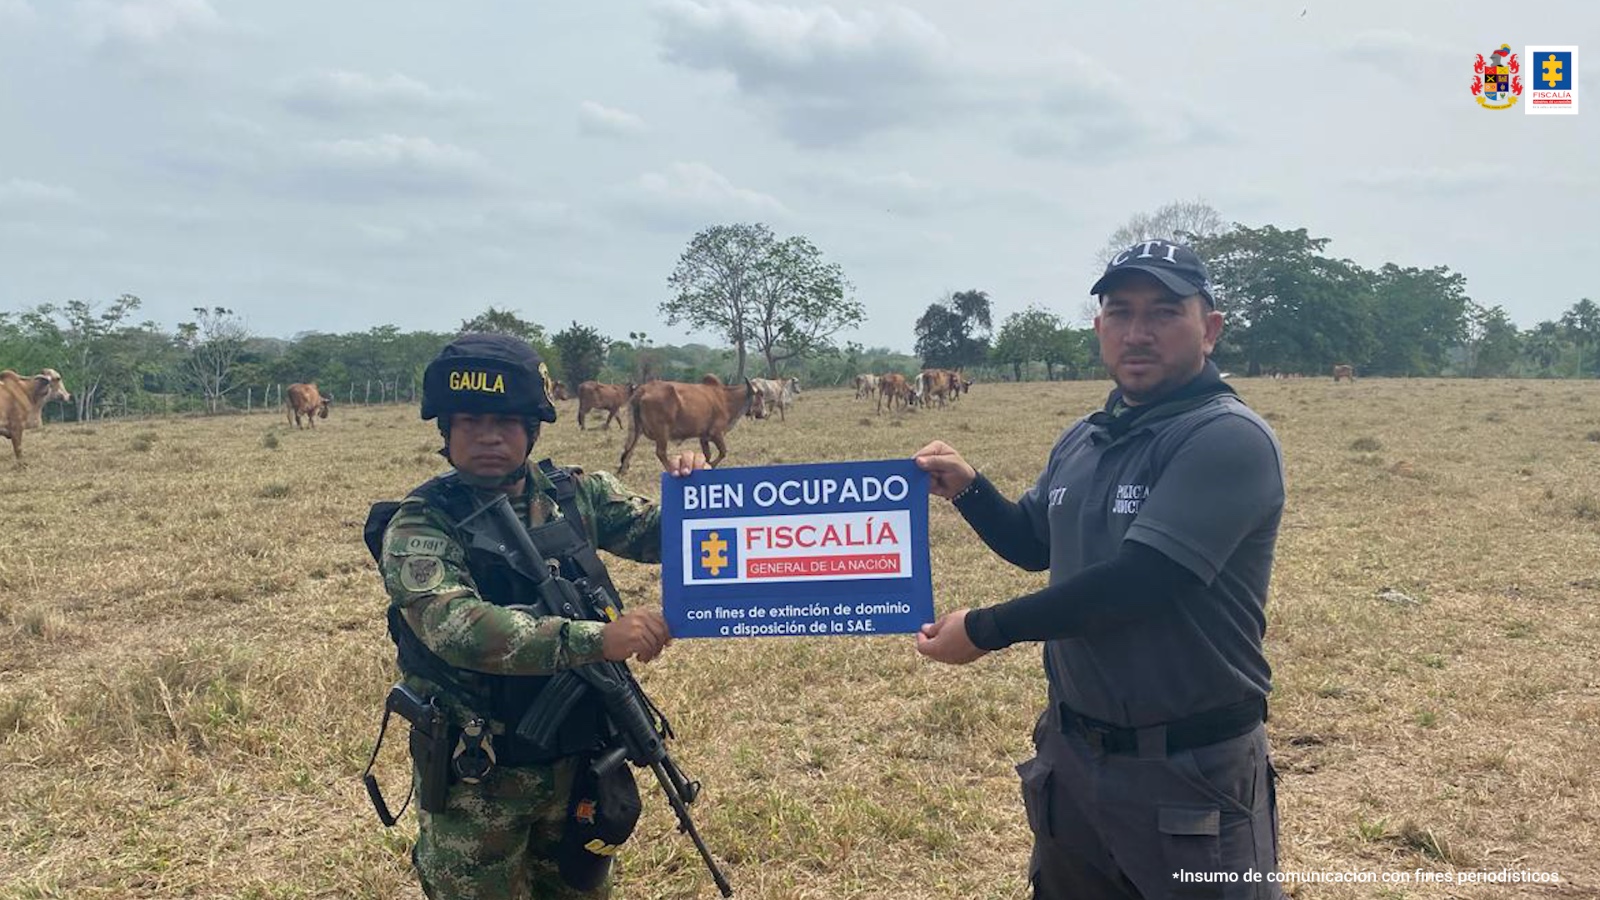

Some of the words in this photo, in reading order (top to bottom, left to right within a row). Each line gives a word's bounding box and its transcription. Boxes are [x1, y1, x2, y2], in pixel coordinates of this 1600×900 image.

[1112, 241, 1179, 266] CTI
[450, 371, 505, 393] GAULA
[684, 483, 743, 510] BIEN
[753, 475, 909, 507] OCUPADO
[746, 517, 898, 549] FISCALÍA
[750, 562, 807, 574] GENERAL
[810, 560, 827, 572] DE
[830, 559, 846, 571] LA
[848, 555, 897, 570] NACIÓN
[687, 609, 711, 620] con
[715, 606, 745, 619] fines
[748, 605, 766, 618] de
[769, 603, 830, 617] extinción
[833, 602, 852, 615] de
[855, 601, 911, 615] dominio
[720, 626, 729, 635] a
[733, 621, 806, 636] disposición
[809, 620, 827, 633] de
[830, 619, 844, 632] la
[847, 619, 876, 632] SAE.
